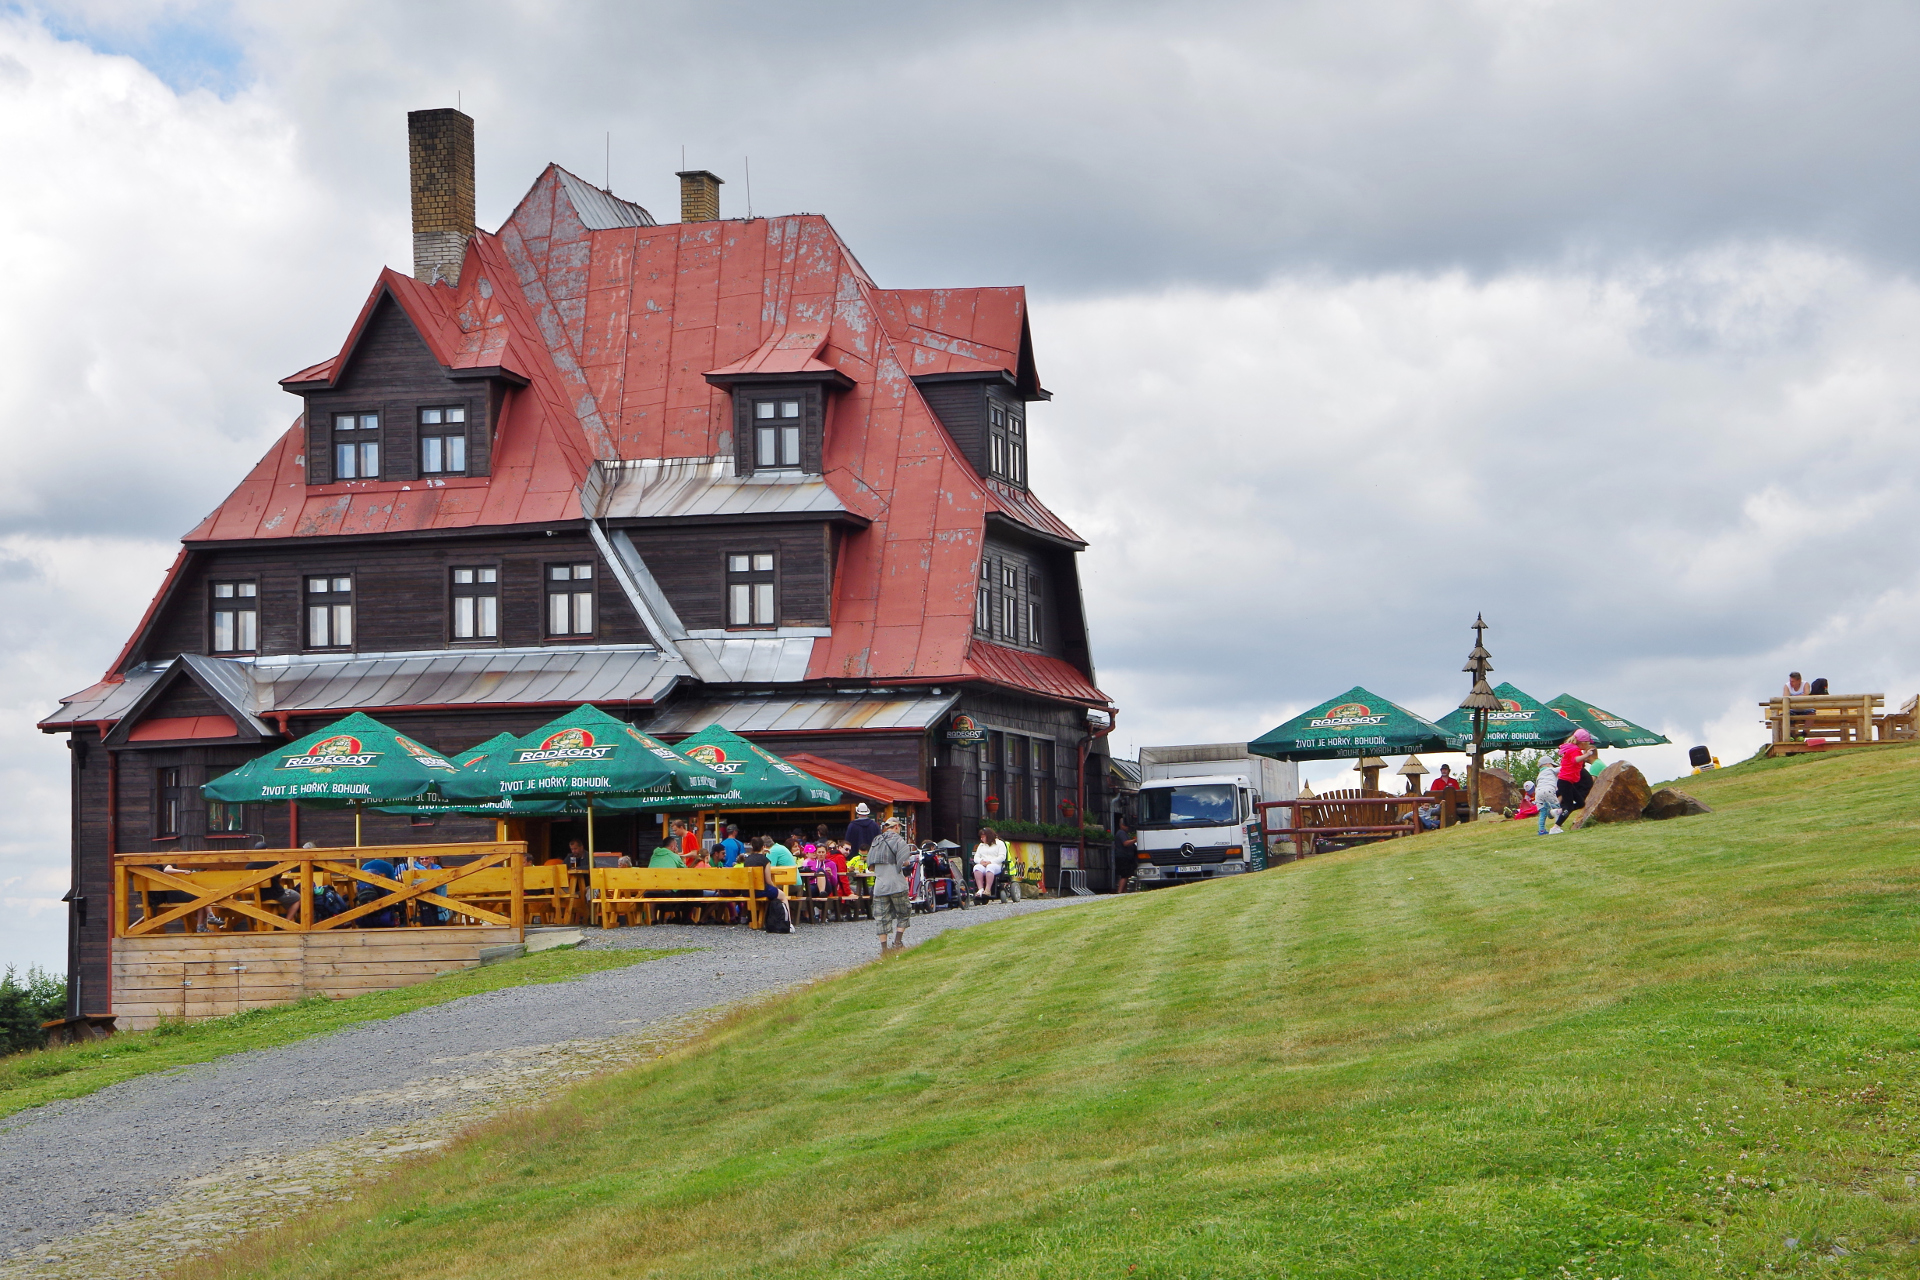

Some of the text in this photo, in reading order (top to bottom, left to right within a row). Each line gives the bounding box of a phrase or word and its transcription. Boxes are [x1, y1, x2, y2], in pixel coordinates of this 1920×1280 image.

[1310, 715, 1386, 727] RADEGAST
[1469, 711, 1536, 720] RDEGAST
[946, 730, 982, 739] RADEGAST
[1487, 731, 1510, 740] HOŘKÝ.
[1511, 732, 1541, 740] BOHUDÍK.
[1295, 738, 1315, 749] ŽIVOT
[1327, 735, 1353, 746] HOŘKÝ.
[1354, 735, 1388, 745] BOHUDÍK.
[284, 754, 377, 768] RADEGAST
[519, 747, 612, 762] RADEGAST
[261, 781, 372, 796] ŽIVOT JE HOŘKÝ. BOHUDÍK.
[500, 775, 612, 792] ŽIVOT JE HOŘKÝ. BOHUDÍK.
